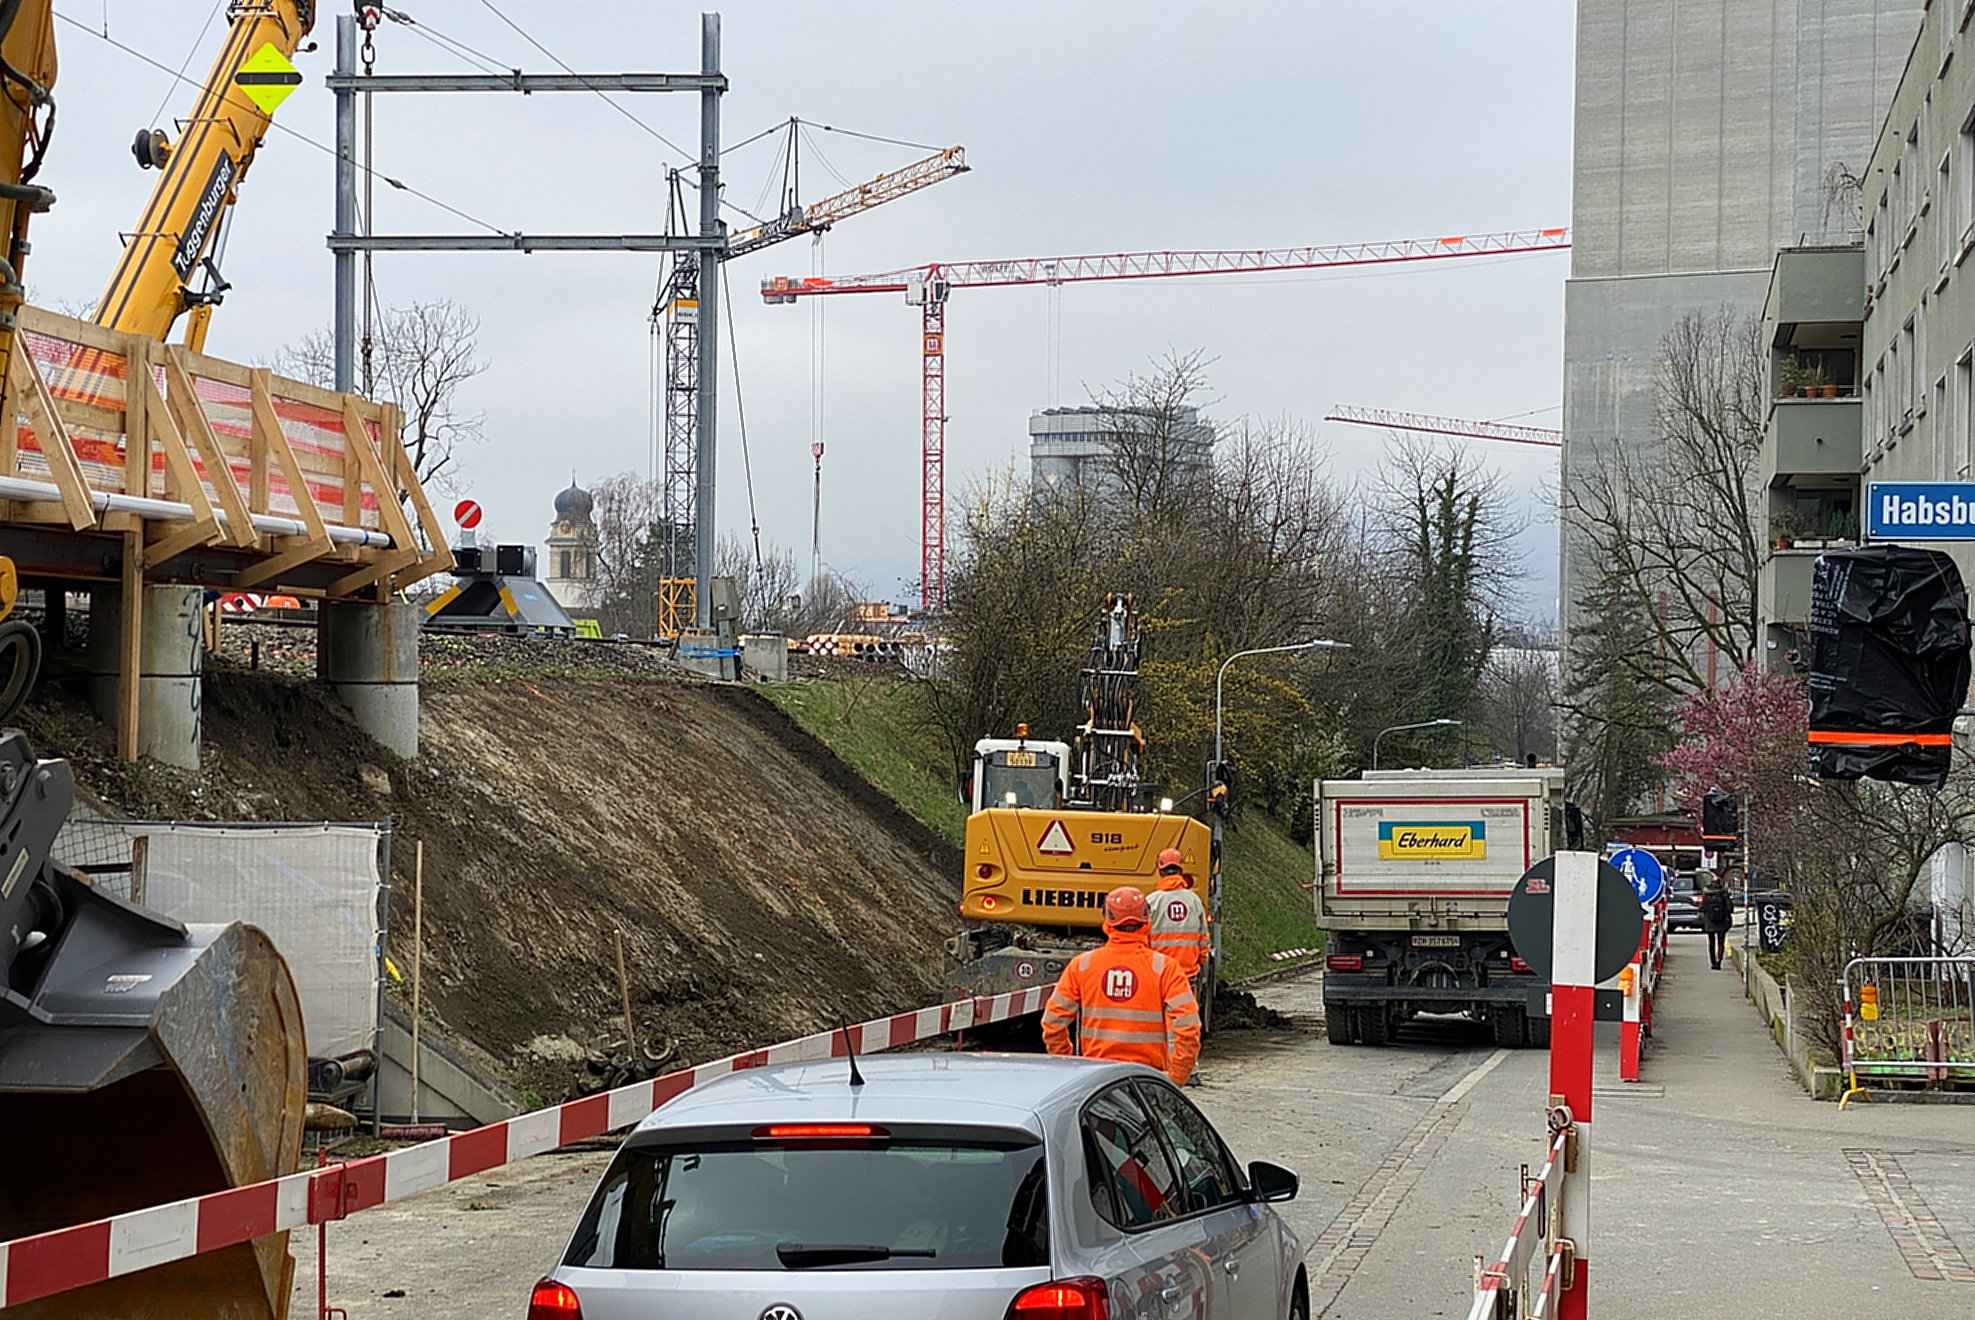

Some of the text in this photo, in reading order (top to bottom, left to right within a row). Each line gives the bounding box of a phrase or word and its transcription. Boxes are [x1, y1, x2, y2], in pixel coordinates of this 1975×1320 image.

[1091, 833, 1122, 844] 918
[1397, 832, 1467, 849] Eberhard
[1022, 889, 1108, 908] LIEBHE
